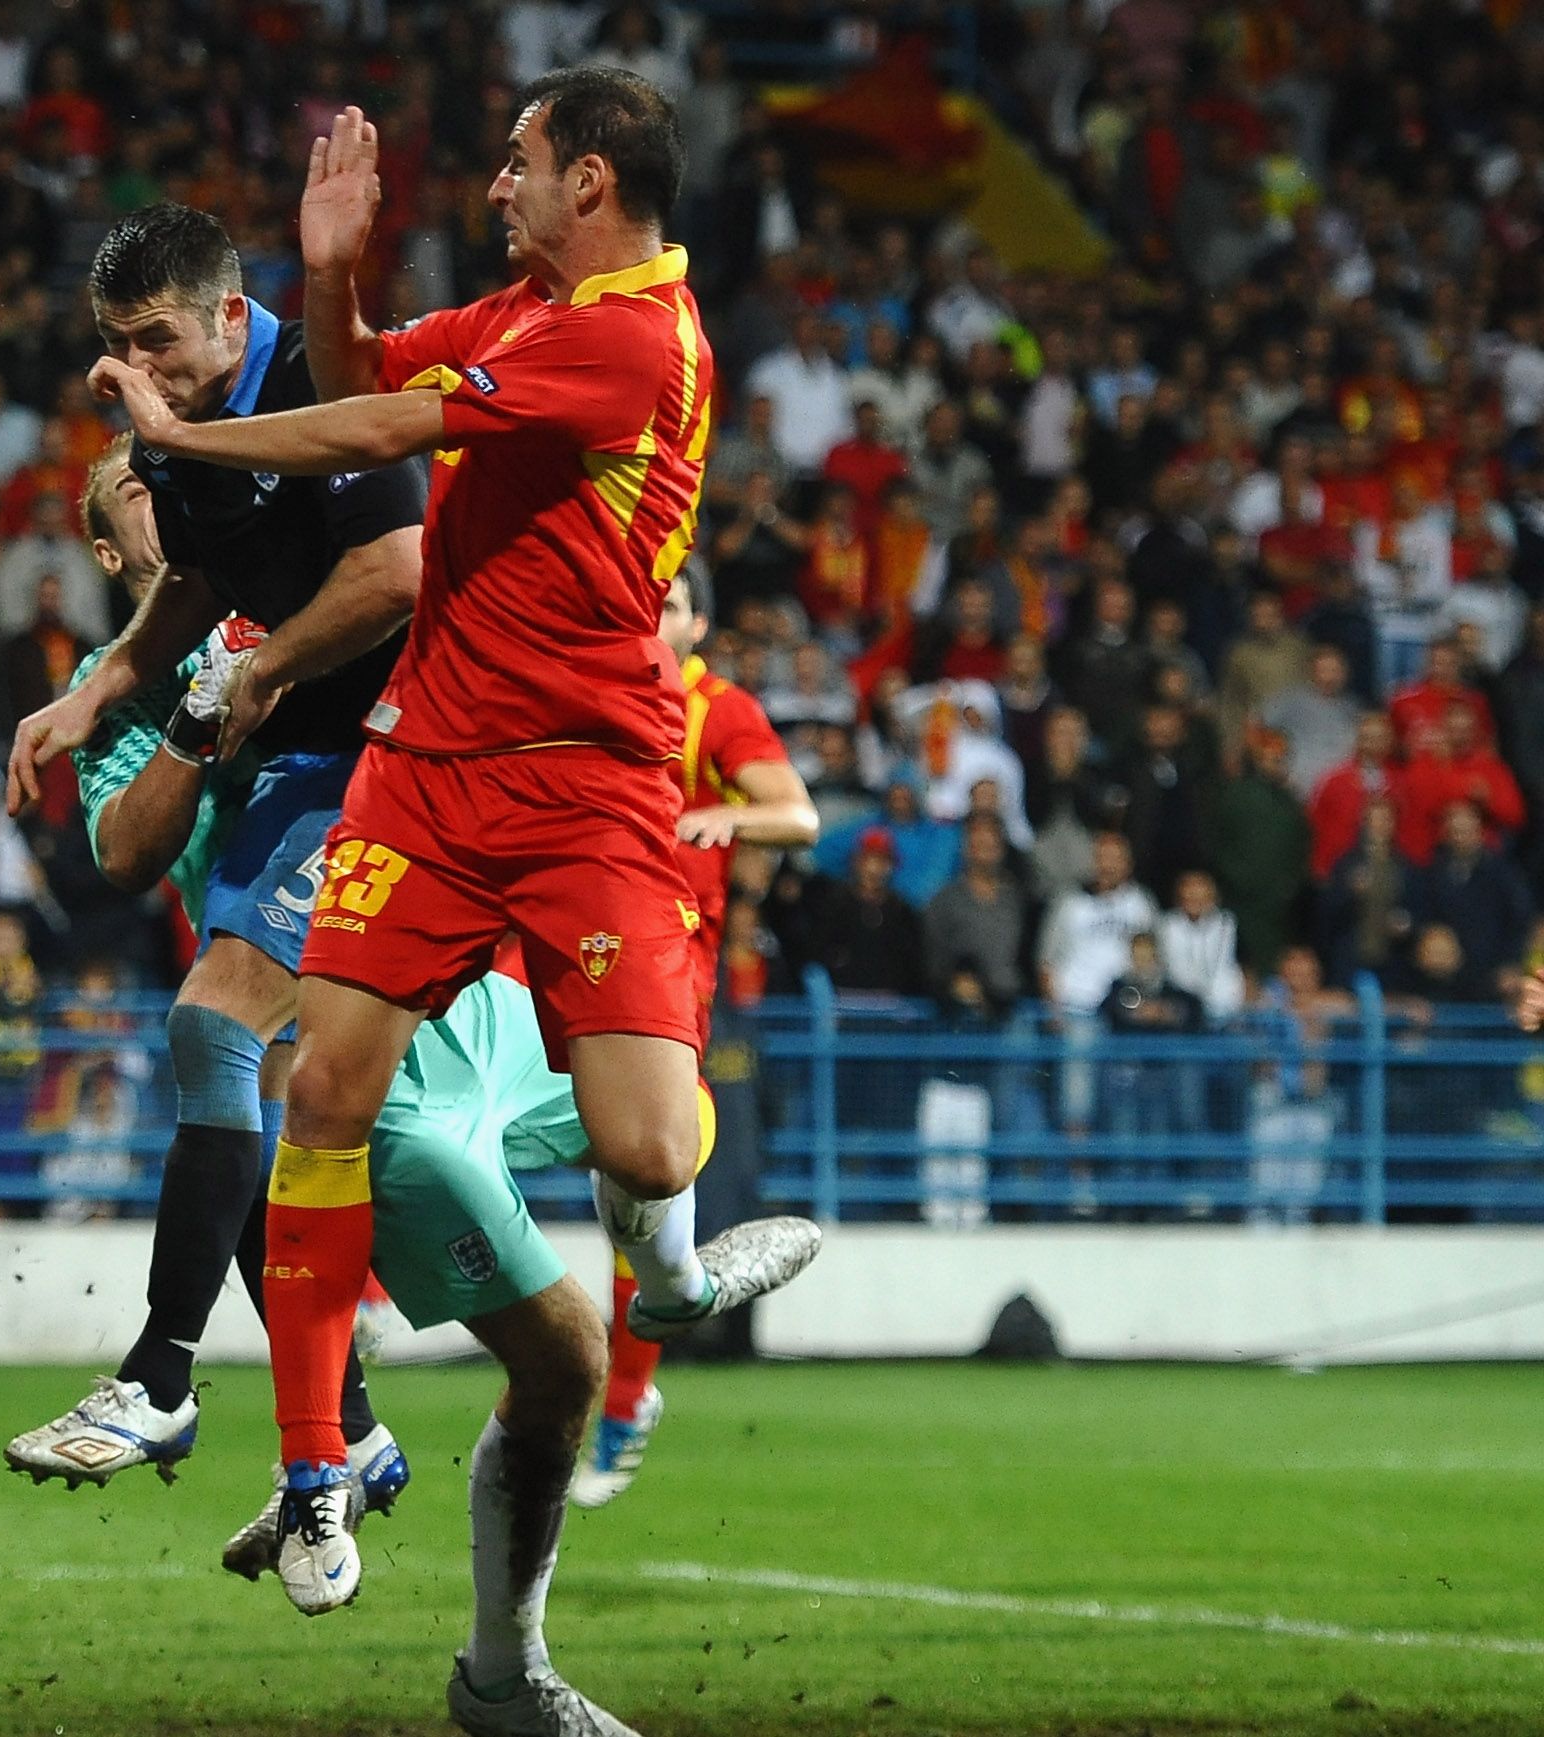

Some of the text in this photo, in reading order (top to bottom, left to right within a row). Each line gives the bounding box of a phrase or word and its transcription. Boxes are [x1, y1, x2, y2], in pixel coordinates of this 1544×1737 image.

[273, 844, 326, 914] 5
[315, 839, 411, 917] 23
[313, 915, 367, 935] LEGEA
